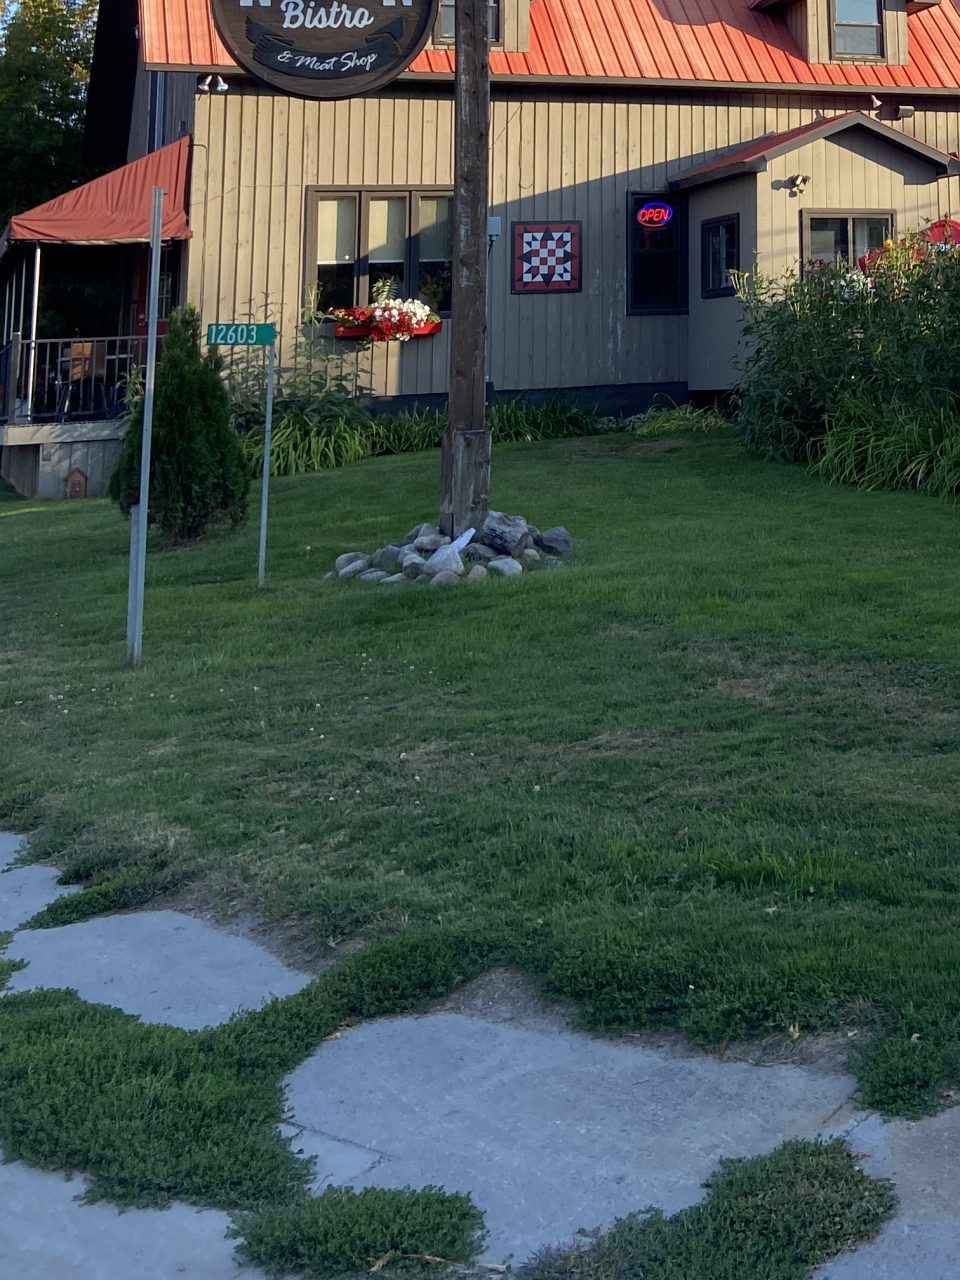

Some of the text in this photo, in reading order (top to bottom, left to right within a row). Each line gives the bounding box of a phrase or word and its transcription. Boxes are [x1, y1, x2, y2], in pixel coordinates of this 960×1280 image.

[277, 50, 378, 72] & Meat Shop
[639, 208, 670, 222] OPEN
[210, 324, 258, 345] 12603
